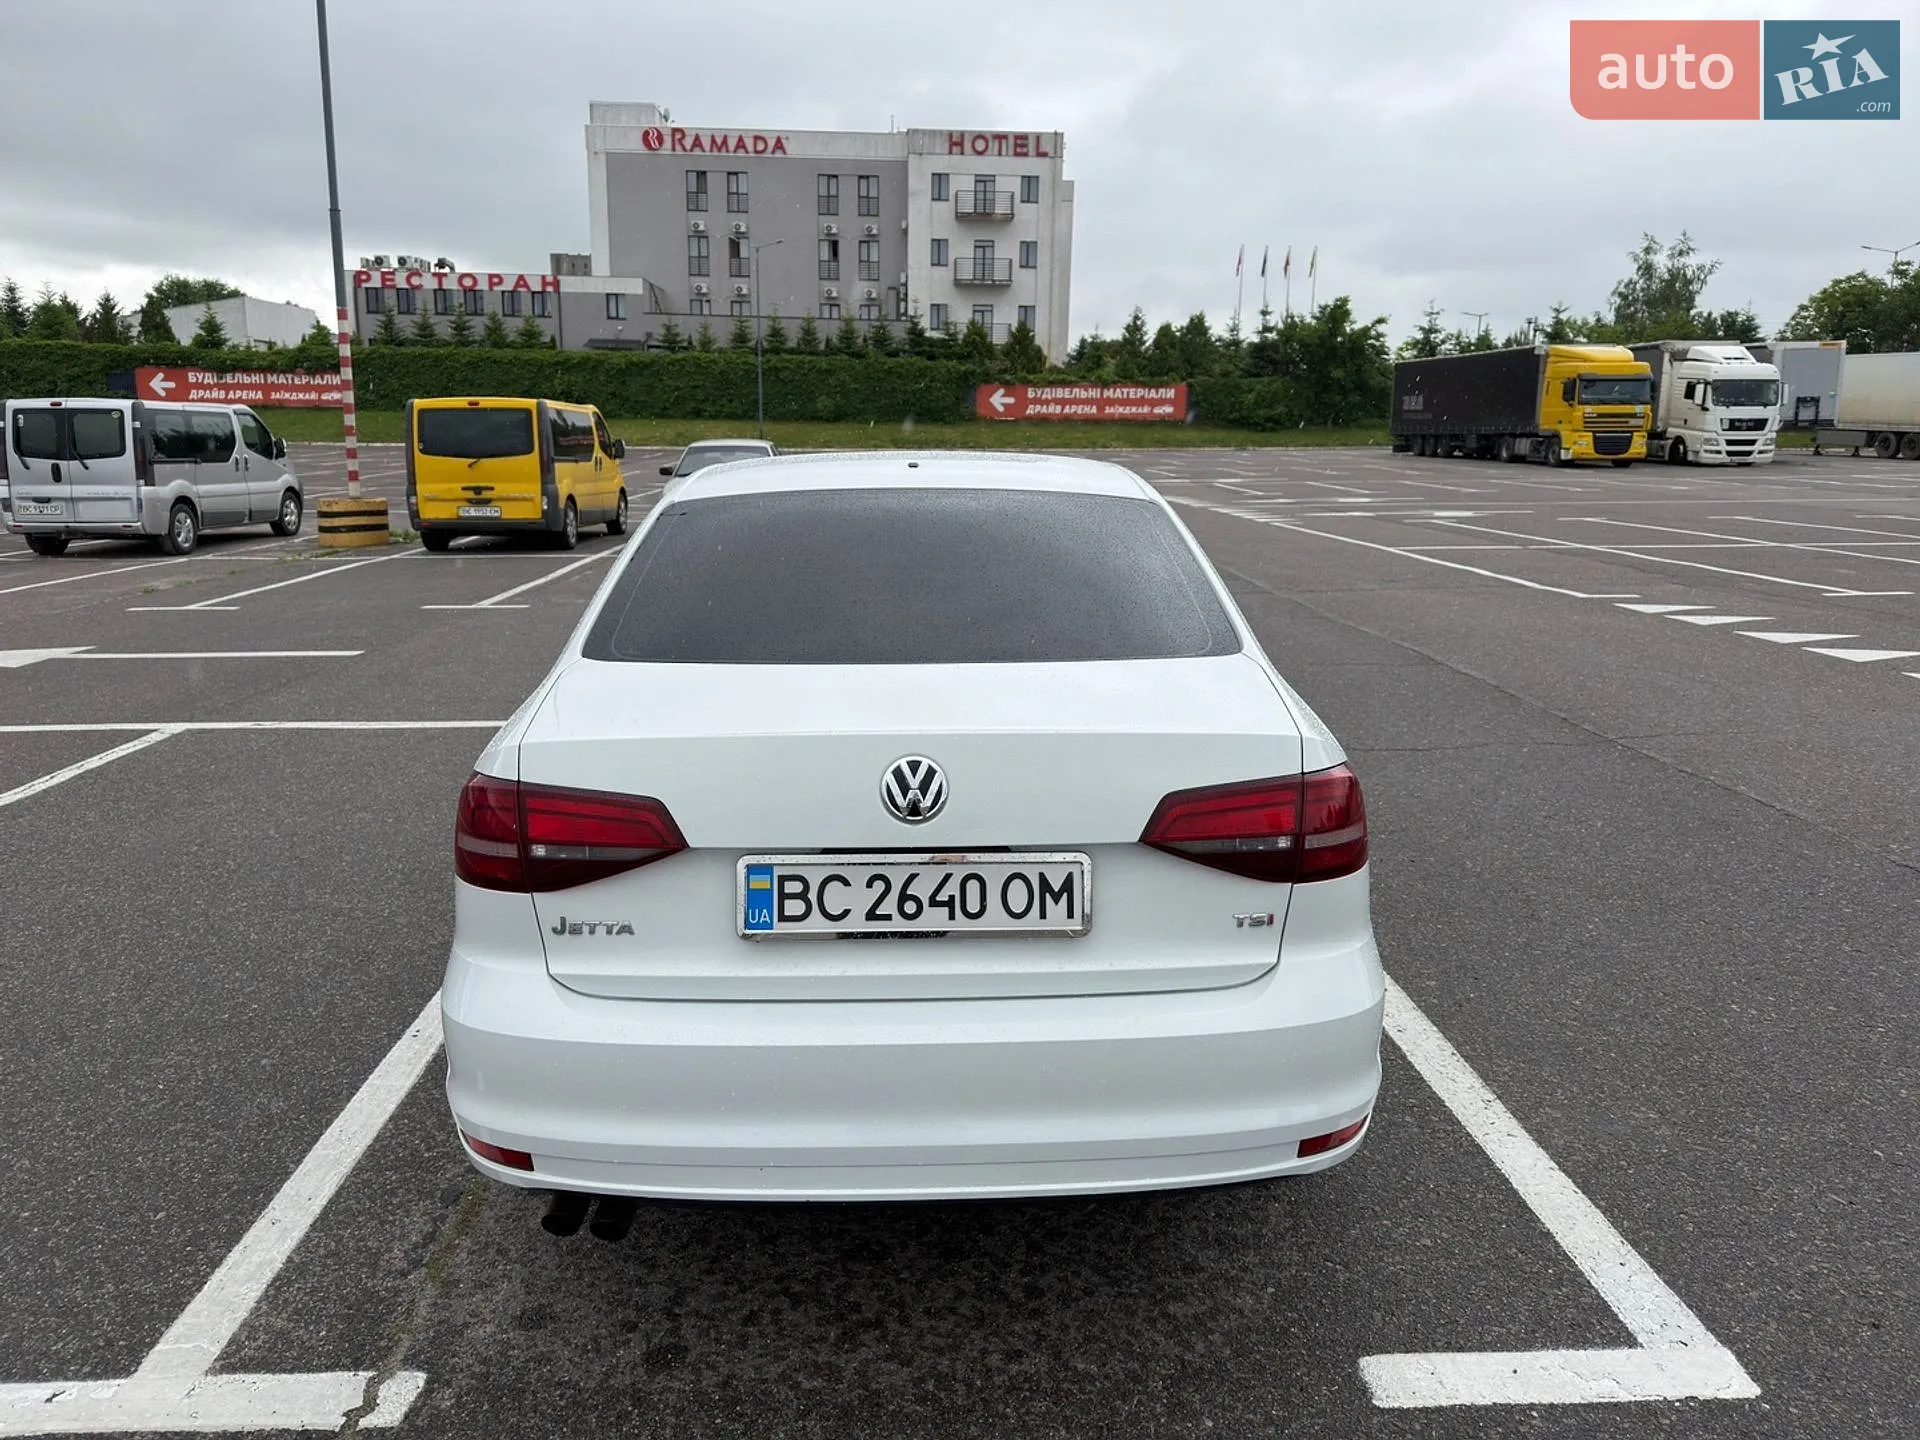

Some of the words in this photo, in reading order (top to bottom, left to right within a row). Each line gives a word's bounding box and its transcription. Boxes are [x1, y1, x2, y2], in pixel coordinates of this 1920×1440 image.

[671, 127, 787, 155] RAMADA
[948, 132, 1049, 157] HOTEL
[353, 270, 560, 293] РЕСТОРАН
[189, 387, 226, 400] ДРАЙВ
[227, 390, 263, 400] АРЕНА
[1027, 387, 1100, 399] БУДІВЕЛЬНІ
[1103, 387, 1176, 399] МАТЕРІАЛИ
[1025, 403, 1062, 415] ДРАЙВ
[1063, 404, 1097, 415] АРЕНА
[750, 909, 770, 924] UA
[777, 874, 852, 923] BC
[865, 872, 987, 922] 2640
[1000, 871, 1074, 920] OM
